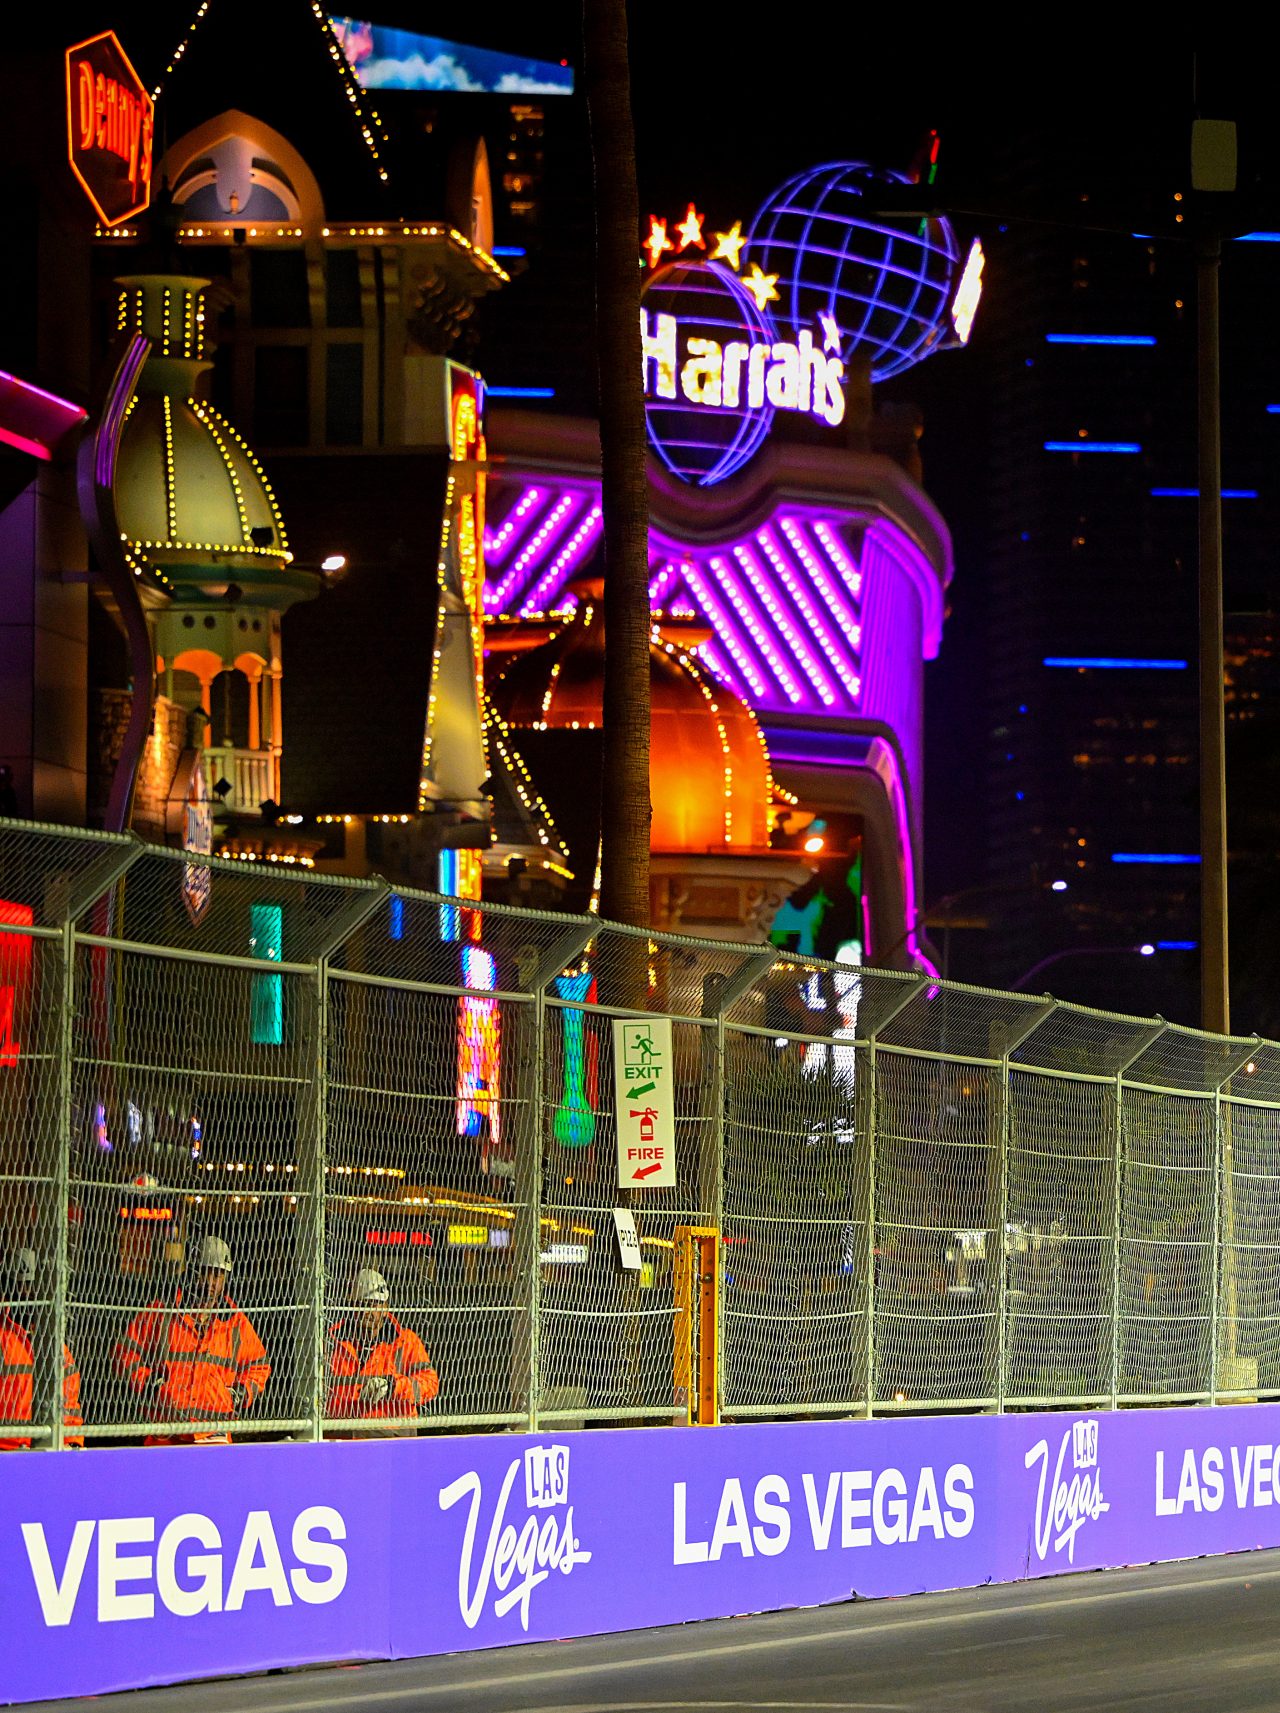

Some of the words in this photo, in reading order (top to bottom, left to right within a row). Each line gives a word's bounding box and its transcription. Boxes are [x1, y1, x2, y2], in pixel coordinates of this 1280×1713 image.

[79, 61, 152, 202] Denny's
[640, 308, 846, 427] Harrah's
[624, 1066, 663, 1079] EXIT
[627, 1147, 664, 1160] FIRE
[527, 1447, 568, 1505] LAS
[1074, 1420, 1098, 1468] LAS
[1155, 1446, 1225, 1516] LAS
[439, 1459, 592, 1631] Vegas
[673, 1474, 791, 1565] LAS
[802, 1463, 975, 1551] VEGAS
[1025, 1430, 1110, 1564] Vegas
[20, 1506, 348, 1627] VEGAS
